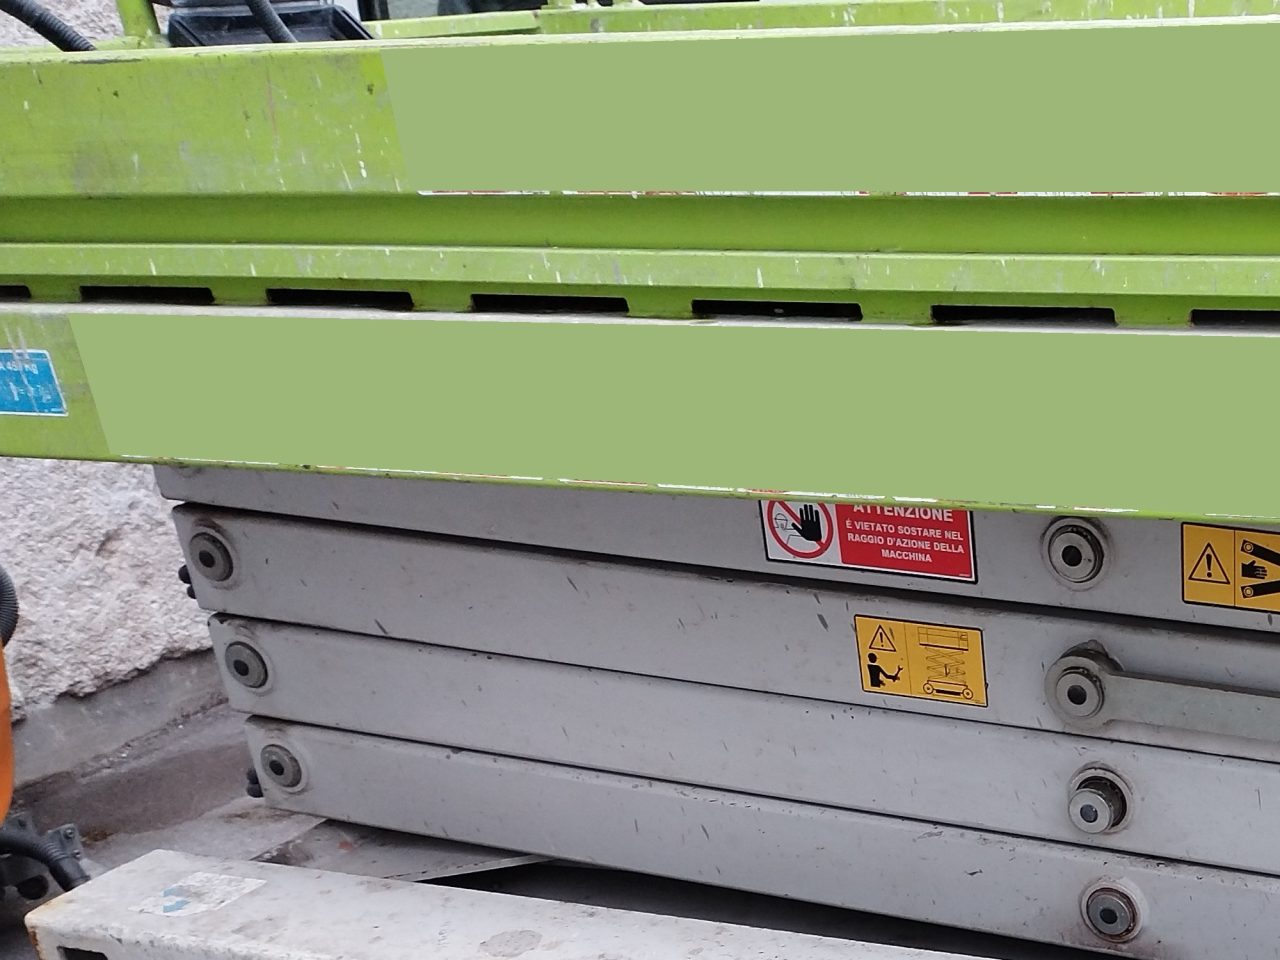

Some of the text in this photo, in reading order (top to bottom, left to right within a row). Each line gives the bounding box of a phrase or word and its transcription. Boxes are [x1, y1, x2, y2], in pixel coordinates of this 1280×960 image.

[854, 521, 895, 533] VIETATO
[897, 525, 941, 538] SOSTARE
[944, 531, 964, 541] NEL
[847, 533, 965, 554] RAGGIO D'AZIONE DELLA
[881, 549, 932, 562] MACCHINA
